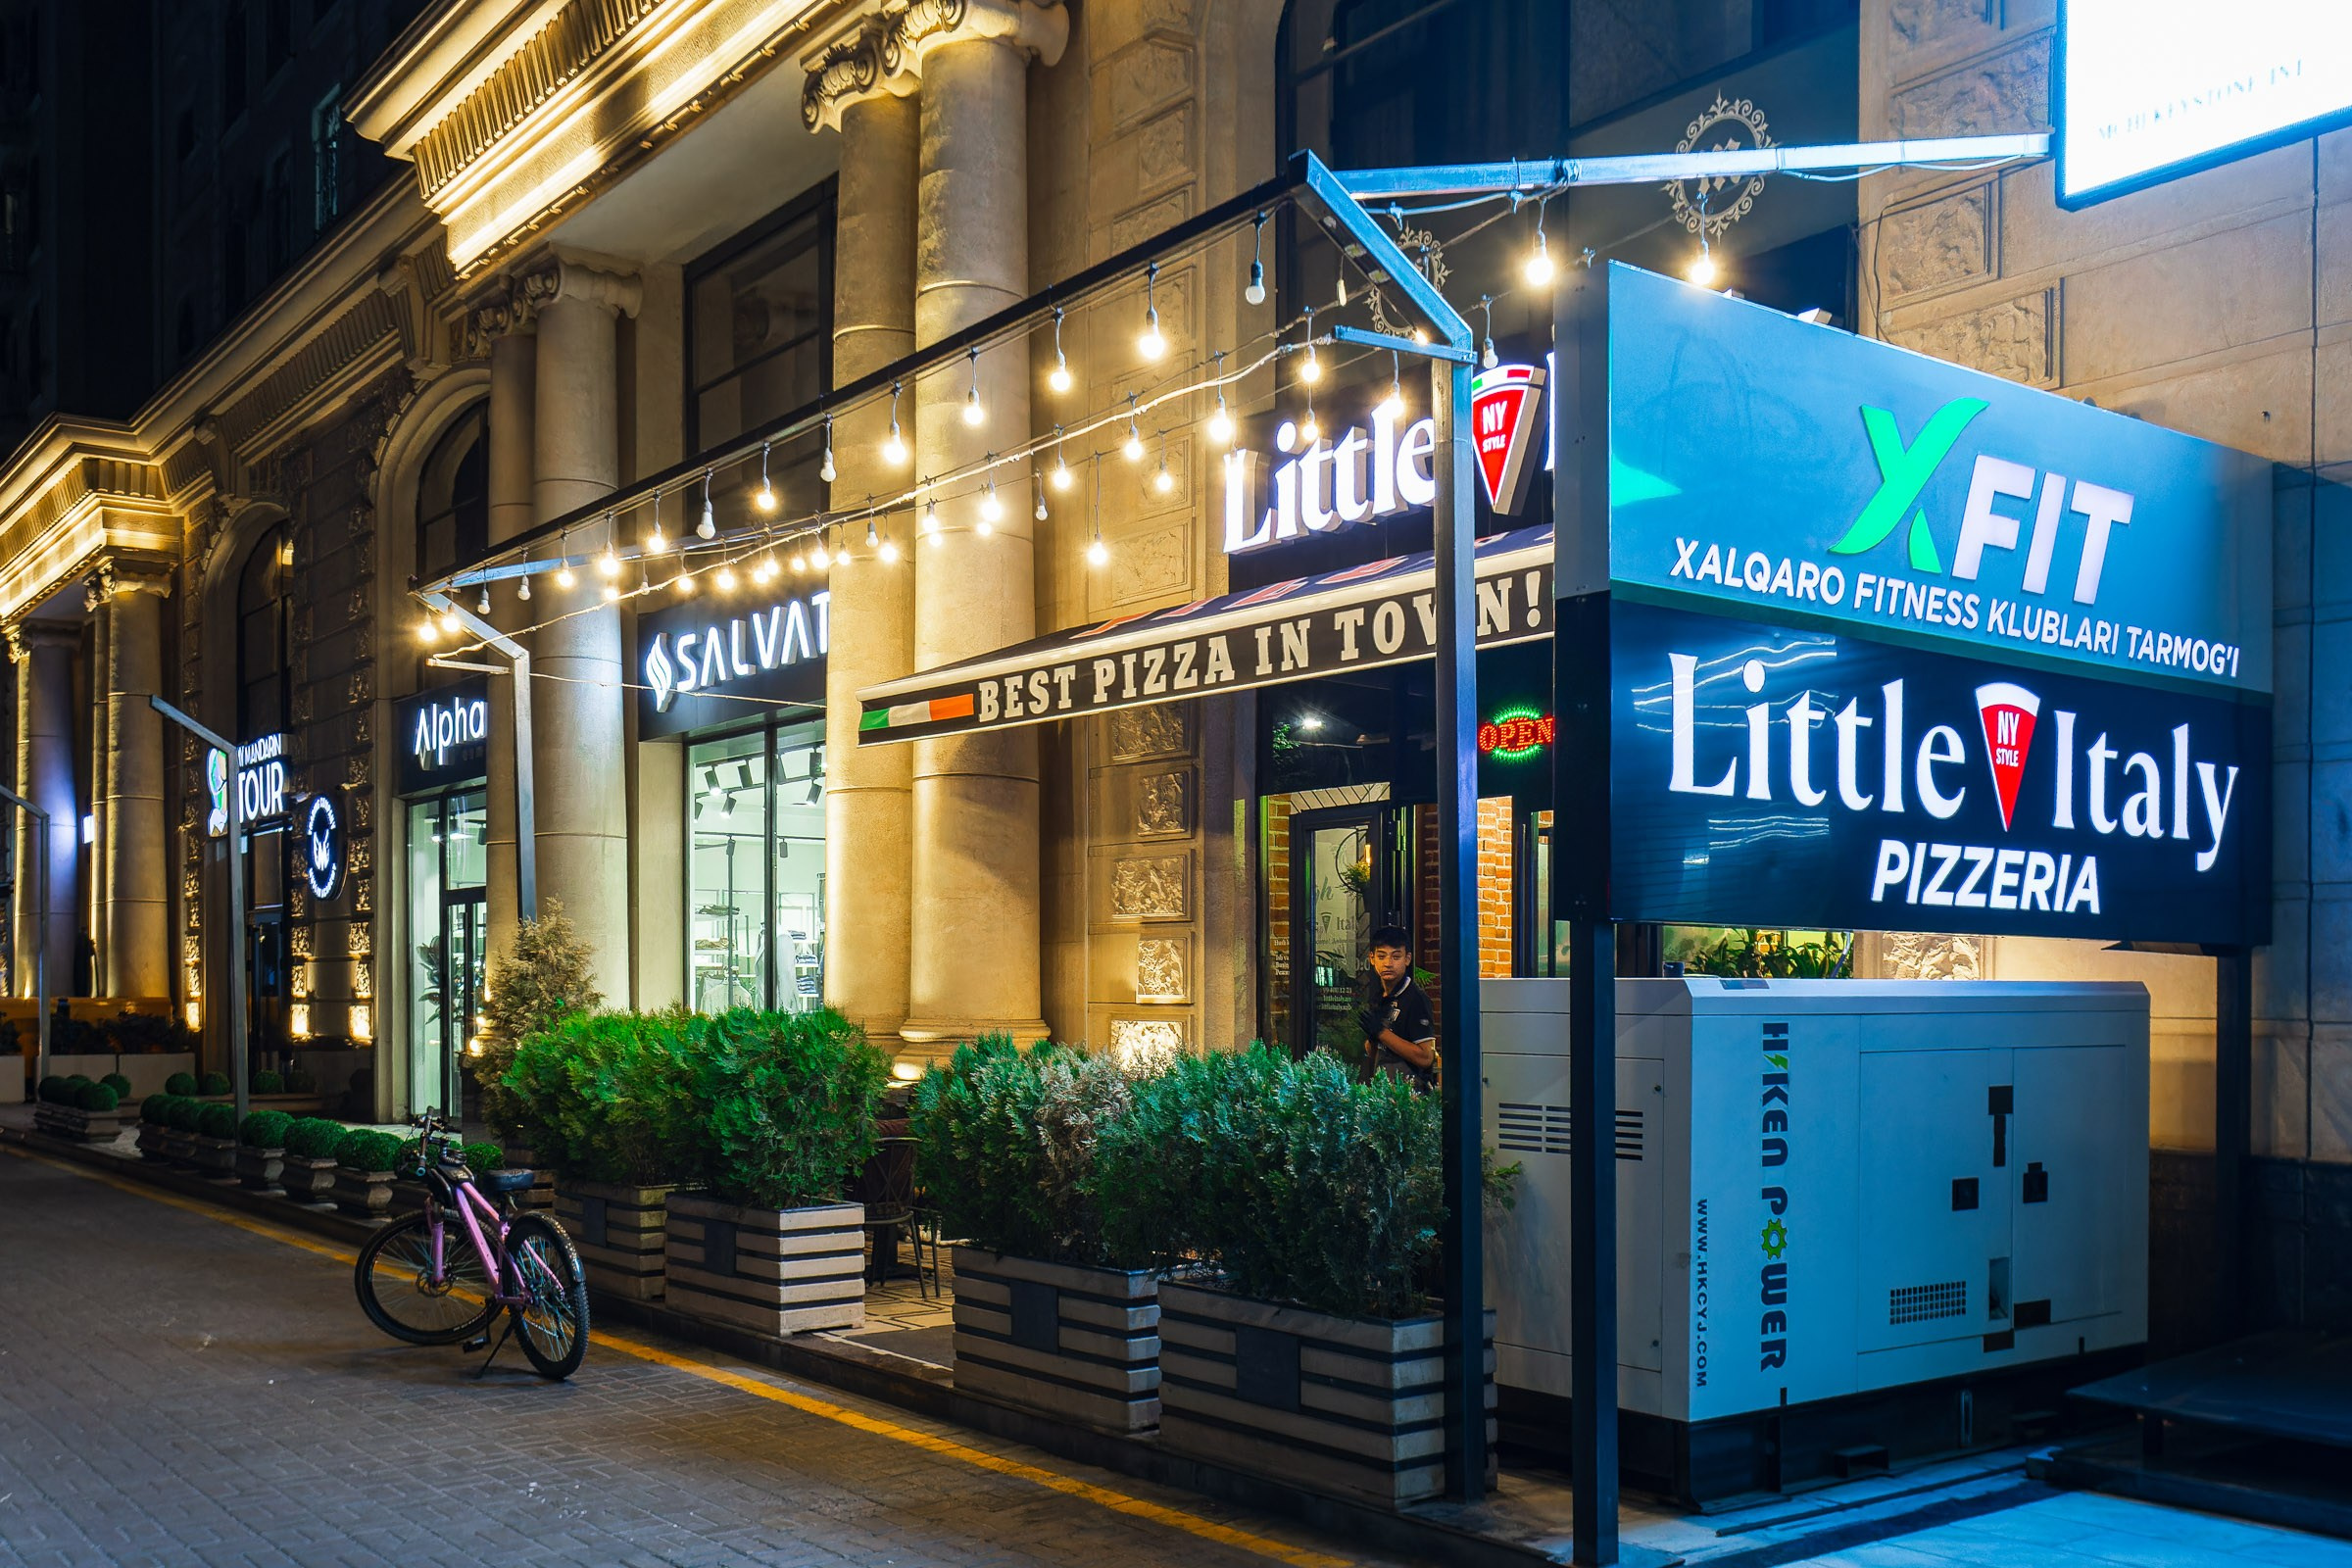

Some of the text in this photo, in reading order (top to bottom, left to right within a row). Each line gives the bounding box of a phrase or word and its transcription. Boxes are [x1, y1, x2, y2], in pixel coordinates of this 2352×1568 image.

[1482, 400, 1508, 434] NY
[1482, 434, 1506, 453] STYLE
[1223, 396, 1437, 554] Little
[1669, 536, 2240, 678] XALQARO FITNESS KLUBLARI TARMOG'I
[978, 664, 1077, 723] BEST
[1093, 635, 1236, 705] PIZZA
[1254, 617, 1312, 676] IN
[415, 696, 486, 765] Alpha
[1478, 716, 1554, 752] OPEN
[1668, 652, 2240, 872] Little Italy
[1995, 748, 2020, 767] STYLE
[1997, 710, 2020, 747] NY
[237, 760, 284, 824] TOUR
[1870, 839, 2102, 914] PIZZERIA
[1696, 1198, 1708, 1388] WWW.HKCYJ.COM
